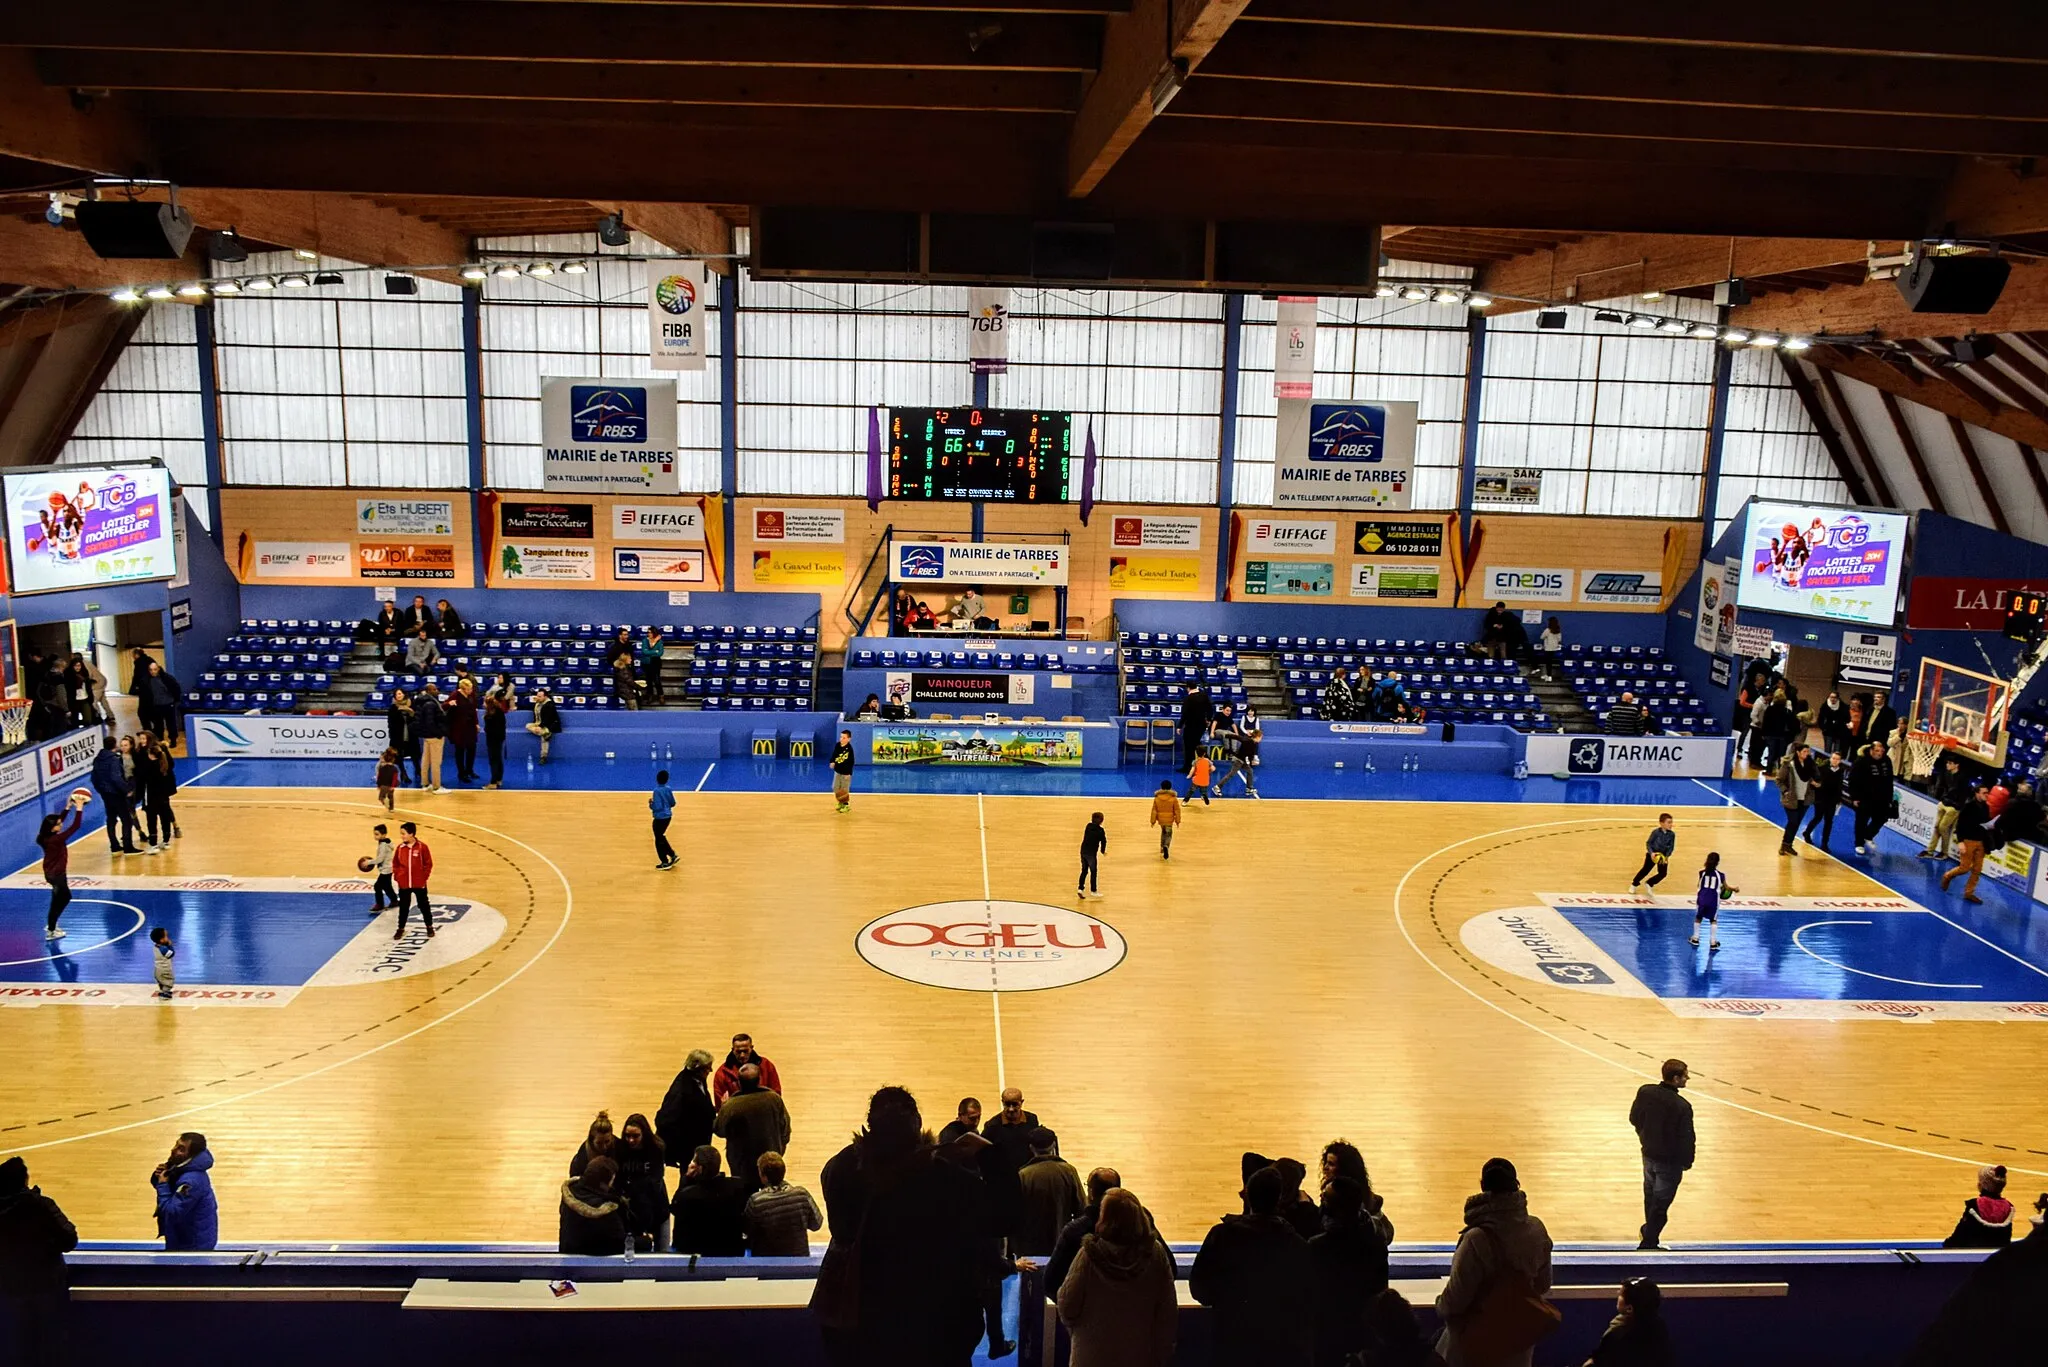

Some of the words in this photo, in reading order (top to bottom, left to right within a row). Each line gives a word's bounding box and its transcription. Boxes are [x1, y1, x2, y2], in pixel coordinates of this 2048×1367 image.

[970, 317, 1003, 331] TGB
[663, 324, 692, 337] FIBA
[664, 339, 690, 347] EUROPE
[587, 424, 638, 438] TARBES
[944, 437, 963, 453] 66
[976, 440, 984, 451] 4
[1005, 440, 1015, 454] 8
[1323, 444, 1374, 457] TARBES
[547, 449, 597, 462] MAIRIE
[600, 450, 617, 462] de
[620, 451, 674, 464] TARBES
[942, 456, 948, 466] 0
[1017, 457, 1024, 467] 3
[610, 476, 645, 484] PARTAGER
[1281, 468, 1331, 481] MAIRIE
[1334, 469, 1352, 482] de
[1354, 470, 1407, 483] TARBES
[1513, 469, 1543, 479] SANZ
[378, 502, 396, 514] Ets
[400, 503, 449, 515] HUBERT
[101, 514, 136, 531] LATTES
[540, 519, 588, 528] Chocolatier
[640, 514, 695, 526] EIFFAGE
[85, 519, 150, 544] MONTPELLIER
[1274, 528, 1328, 541] EIFFAGE
[1412, 532, 1440, 540] ESTRADE
[523, 548, 564, 558] Sanguinet
[1386, 544, 1396, 552] 06
[361, 546, 415, 566] wipi!
[949, 548, 993, 560] MAIRIE
[996, 548, 1011, 560] de
[1013, 550, 1059, 561] TARBES
[621, 559, 638, 567] seb
[1825, 556, 1862, 567] LATTES
[444, 570, 454, 578] 90
[908, 567, 939, 576] TARBES
[1807, 564, 1876, 577] MONTPELLIER
[1954, 589, 1990, 610] LA
[1734, 631, 1772, 641] Sandwiches
[1735, 625, 1773, 636] CHAPITEAU
[1738, 644, 1766, 652] Saucisse
[1845, 646, 1892, 659] CHAPITEAU
[1842, 655, 1872, 665] BUVETTE
[928, 679, 993, 690] VAINQUEUR
[986, 692, 1004, 700] 2015
[268, 727, 339, 739] TOUJAS
[344, 728, 358, 739] &
[62, 734, 96, 757] RENAULT
[65, 746, 95, 768] TRUCKS
[950, 754, 1002, 762] AUTREMENT
[1608, 745, 1683, 761] TARMAC
[1901, 803, 1934, 824] Sud-Ouest
[1704, 875, 1716, 889] 11
[1577, 896, 1655, 904] LOXAM
[1719, 899, 1782, 908] OXAM
[1829, 900, 1908, 909] LOXAM
[870, 922, 1108, 950] OGEU
[1498, 916, 1563, 960] TARMAC
